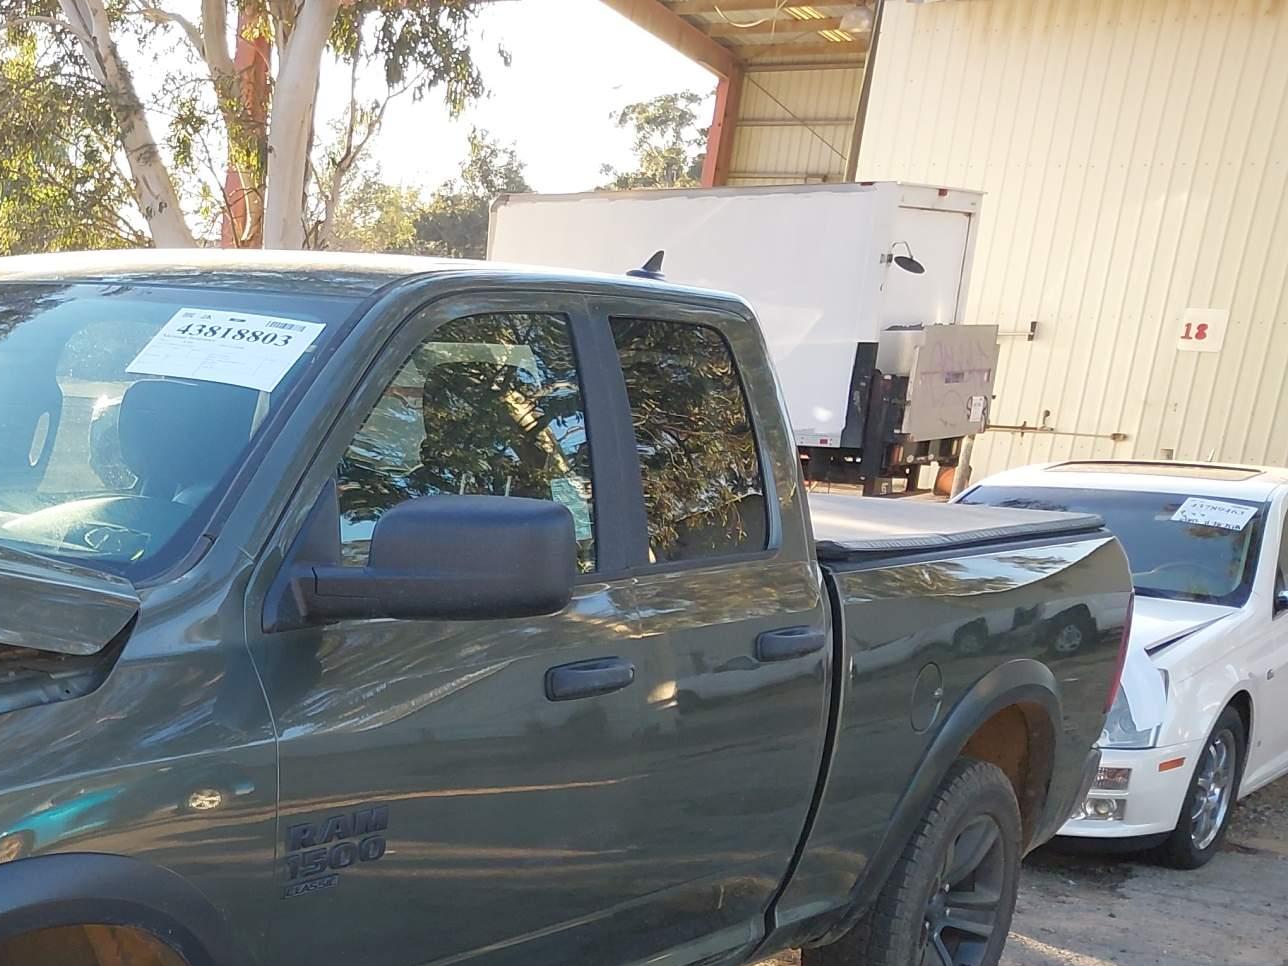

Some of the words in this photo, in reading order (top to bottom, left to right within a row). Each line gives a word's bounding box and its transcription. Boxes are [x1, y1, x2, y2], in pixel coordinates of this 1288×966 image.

[176, 322, 293, 347] 43818803
[1180, 321, 1209, 341] 18
[286, 805, 389, 850] RAM
[281, 834, 386, 880] 1500
